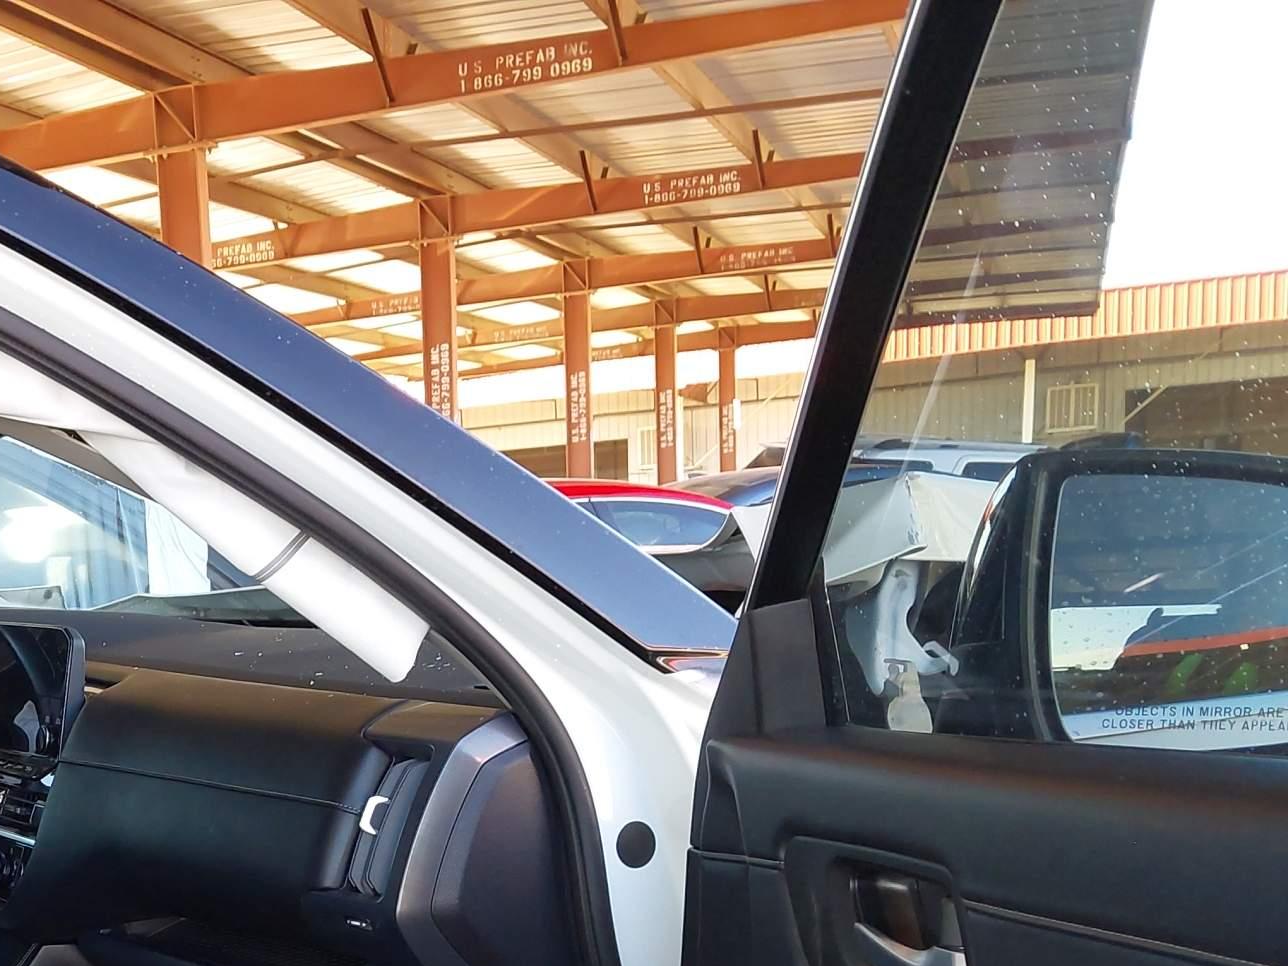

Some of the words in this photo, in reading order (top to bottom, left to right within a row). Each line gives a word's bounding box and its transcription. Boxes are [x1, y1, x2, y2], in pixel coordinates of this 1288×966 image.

[495, 46, 556, 70] PREFAB
[564, 40, 594, 57] INC.
[670, 174, 714, 190] PREFAB
[1114, 705, 1177, 717] OBJECTS
[1182, 706, 1195, 717] IN
[1199, 706, 1252, 718] MIRROR
[1257, 707, 1284, 718] ARE
[1102, 718, 1154, 730] CLOSER
[1161, 719, 1195, 731] THAN
[1202, 719, 1237, 731] THEY
